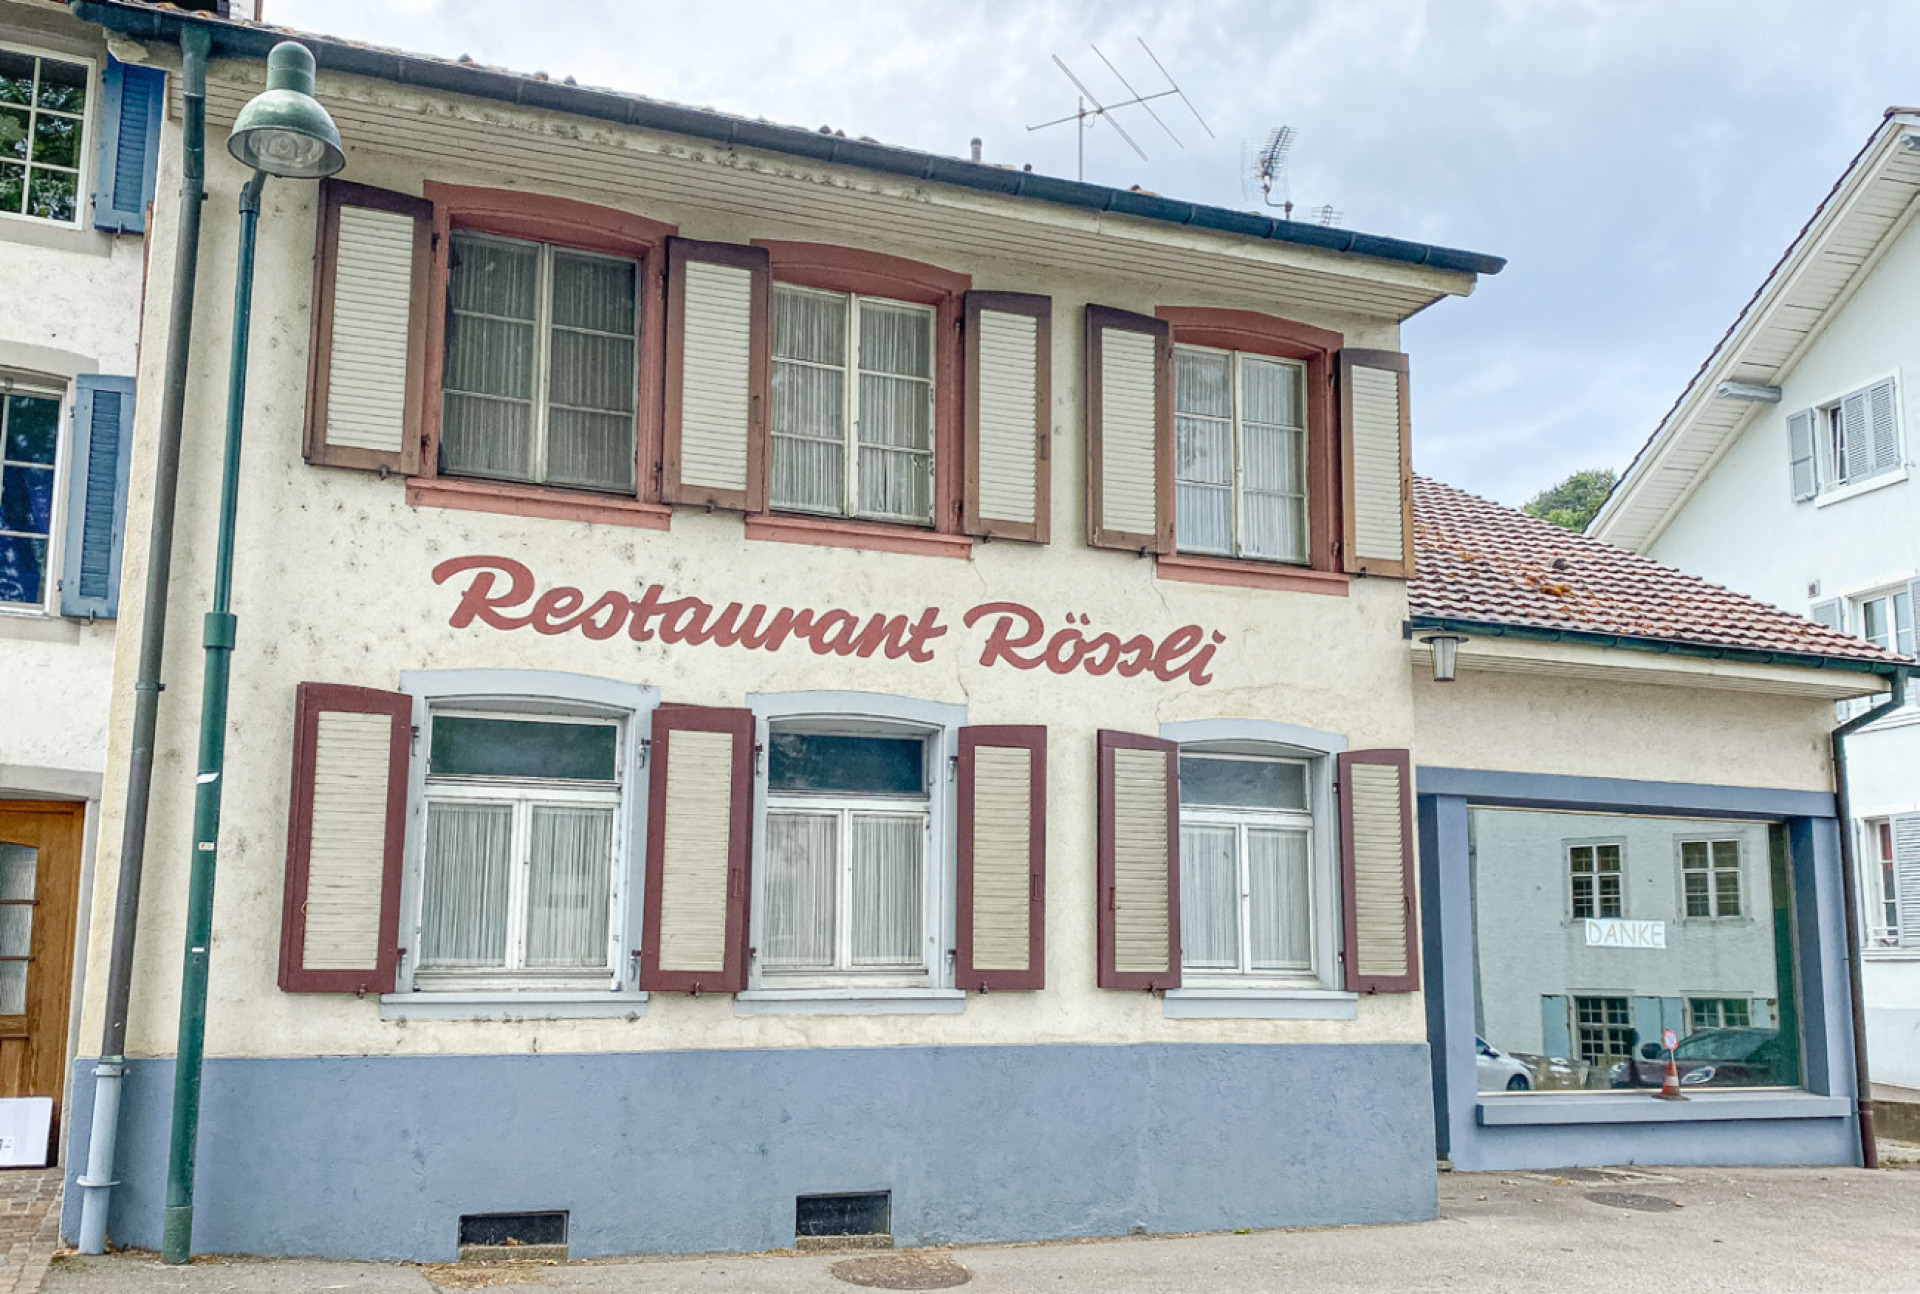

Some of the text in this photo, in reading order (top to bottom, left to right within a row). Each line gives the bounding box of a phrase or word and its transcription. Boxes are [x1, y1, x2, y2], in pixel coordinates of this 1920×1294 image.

[432, 555, 1225, 686] Restaurant Rössli
[1588, 921, 1664, 946] DANKE
